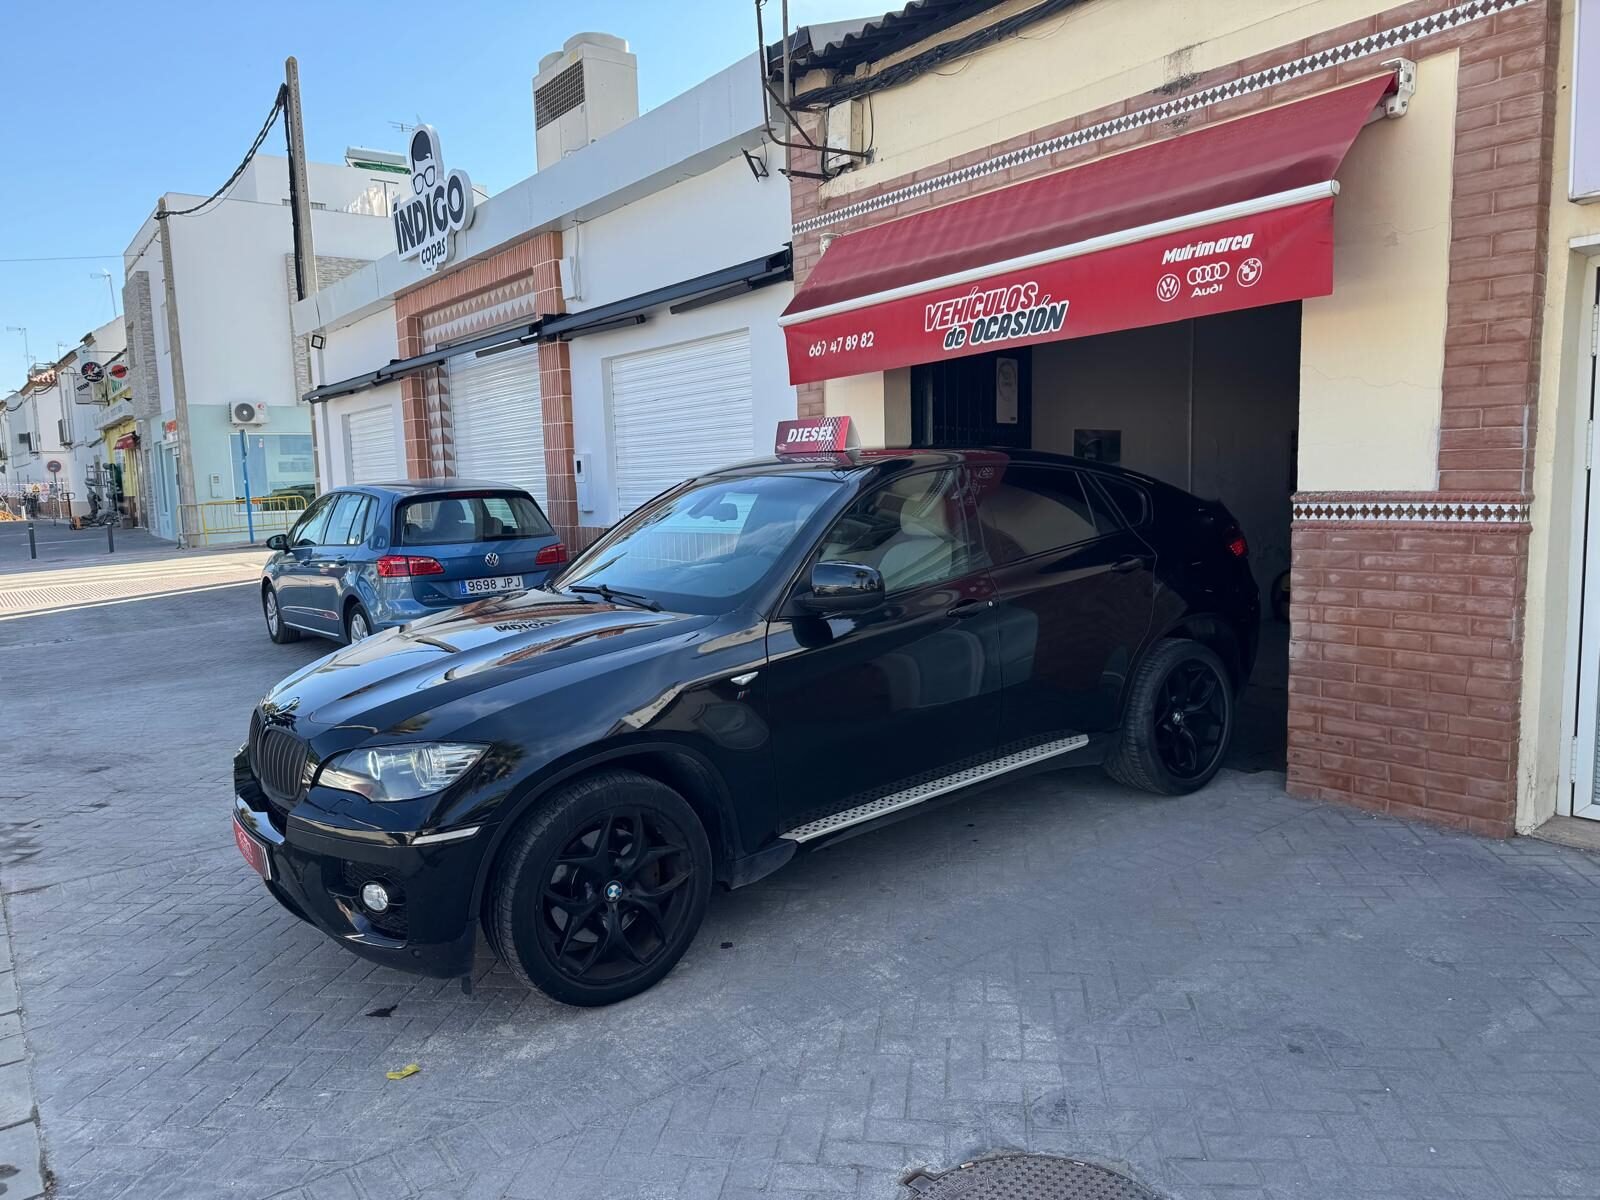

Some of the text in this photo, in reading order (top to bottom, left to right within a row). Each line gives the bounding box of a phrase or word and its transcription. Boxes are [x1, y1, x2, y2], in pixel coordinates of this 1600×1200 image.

[421, 236, 446, 266] copas
[1191, 284, 1223, 298] Audi
[925, 281, 1038, 332] VEHÍCULOS
[943, 294, 1069, 350] de OCASIÓN
[830, 337, 844, 353] 47
[845, 334, 859, 351] 89
[860, 331, 875, 348] 82
[787, 425, 834, 443] DIESEL
[467, 578, 497, 592] 9698
[501, 576, 521, 589] JPJ
